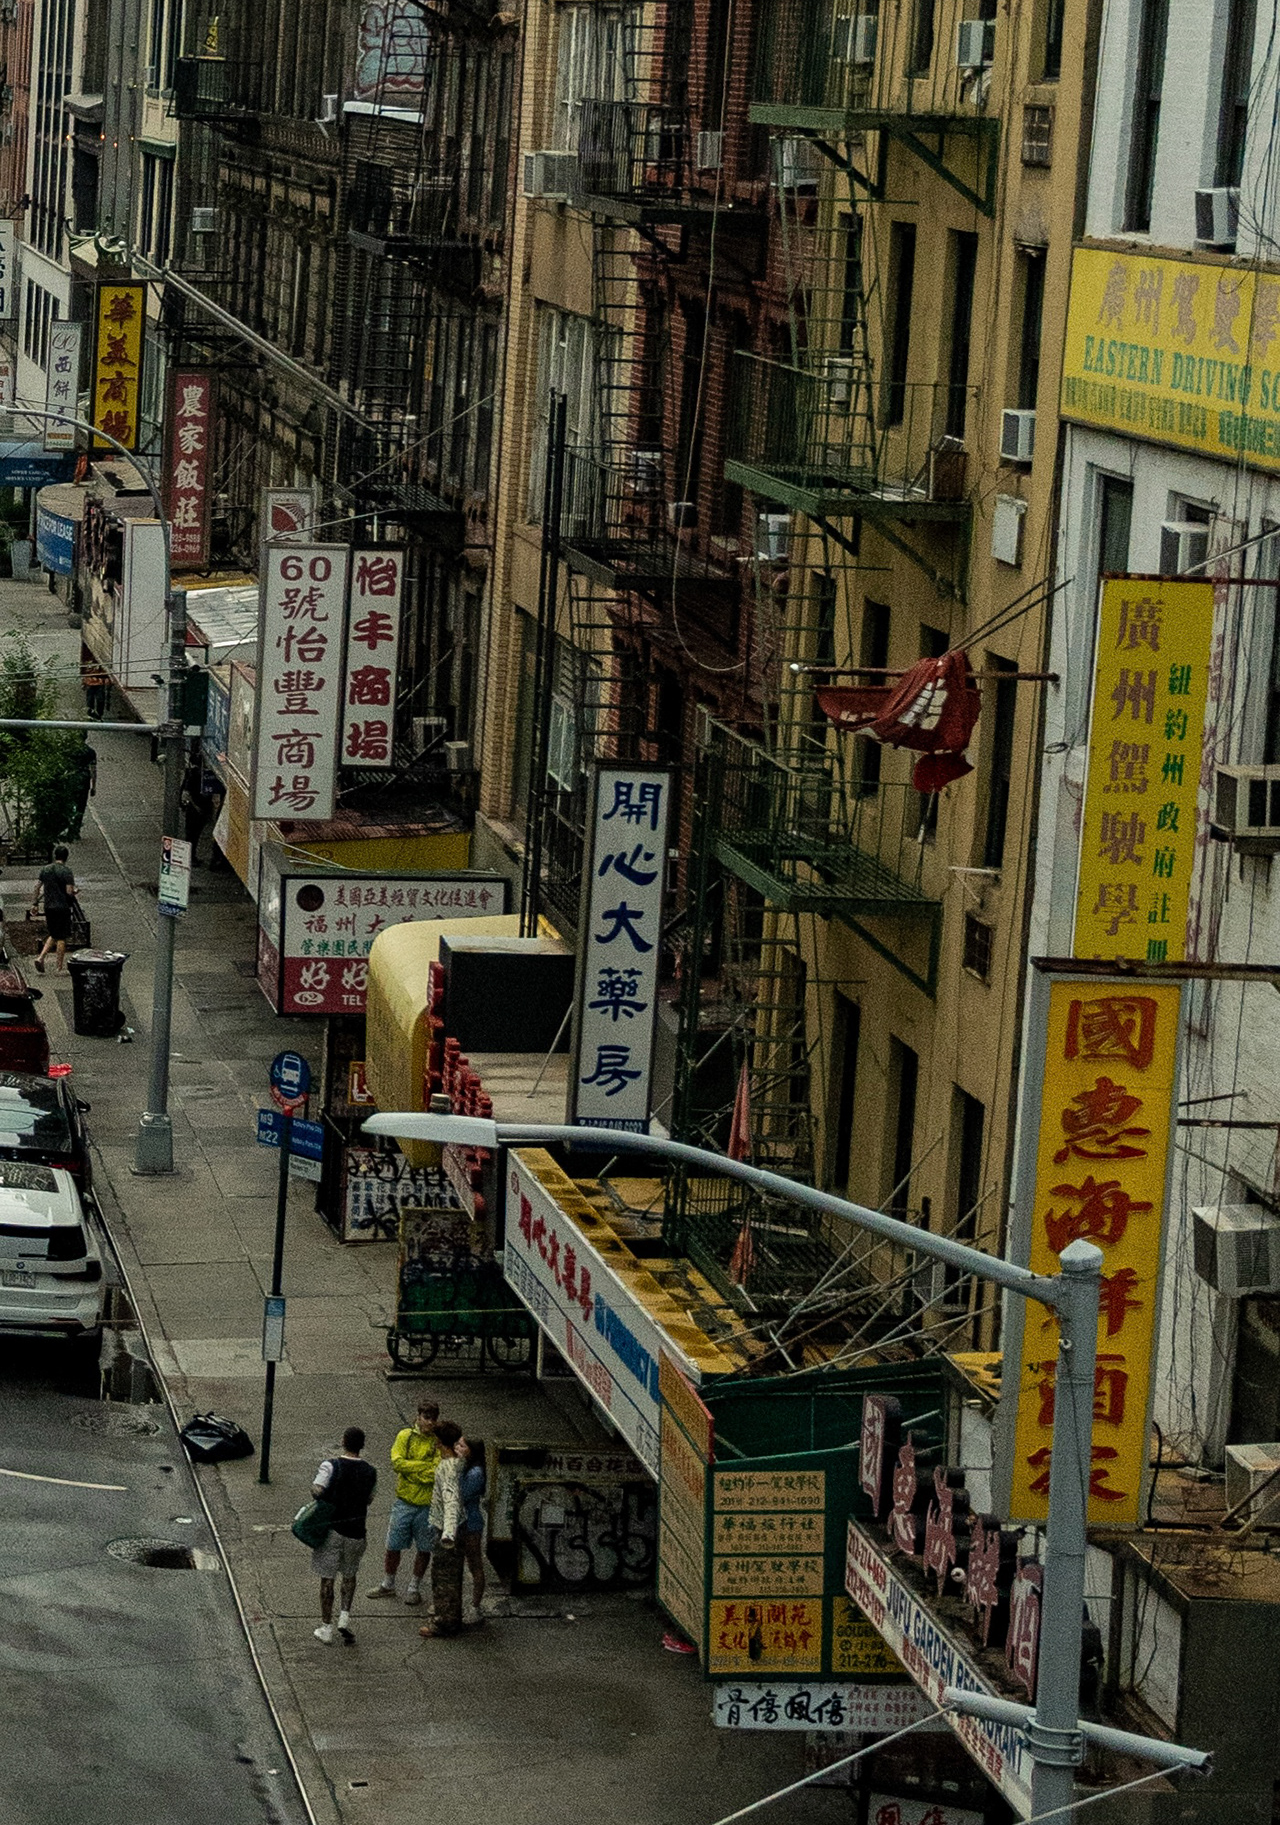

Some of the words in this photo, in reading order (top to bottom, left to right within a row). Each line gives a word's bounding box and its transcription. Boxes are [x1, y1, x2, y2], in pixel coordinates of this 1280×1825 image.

[99, 292, 138, 442] 華美商場
[1083, 335, 1163, 385] EASTERN
[1170, 351, 1252, 406] DRIVING
[173, 384, 207, 530] 農家飯莊
[1092, 596, 1165, 960] 廣州駕駛學
[581, 781, 662, 1097] 開心大藥房
[298, 992, 319, 1004] 62
[341, 994, 362, 1006] TEL
[259, 1129, 289, 1144] M22
[260, 1112, 285, 1126] M9
[718, 1688, 847, 1726] 骨傷風傷
[886, 1573, 911, 1637] JUFU
[912, 1613, 954, 1681] GARDEN
[956, 1656, 1023, 1775] RESURANT
